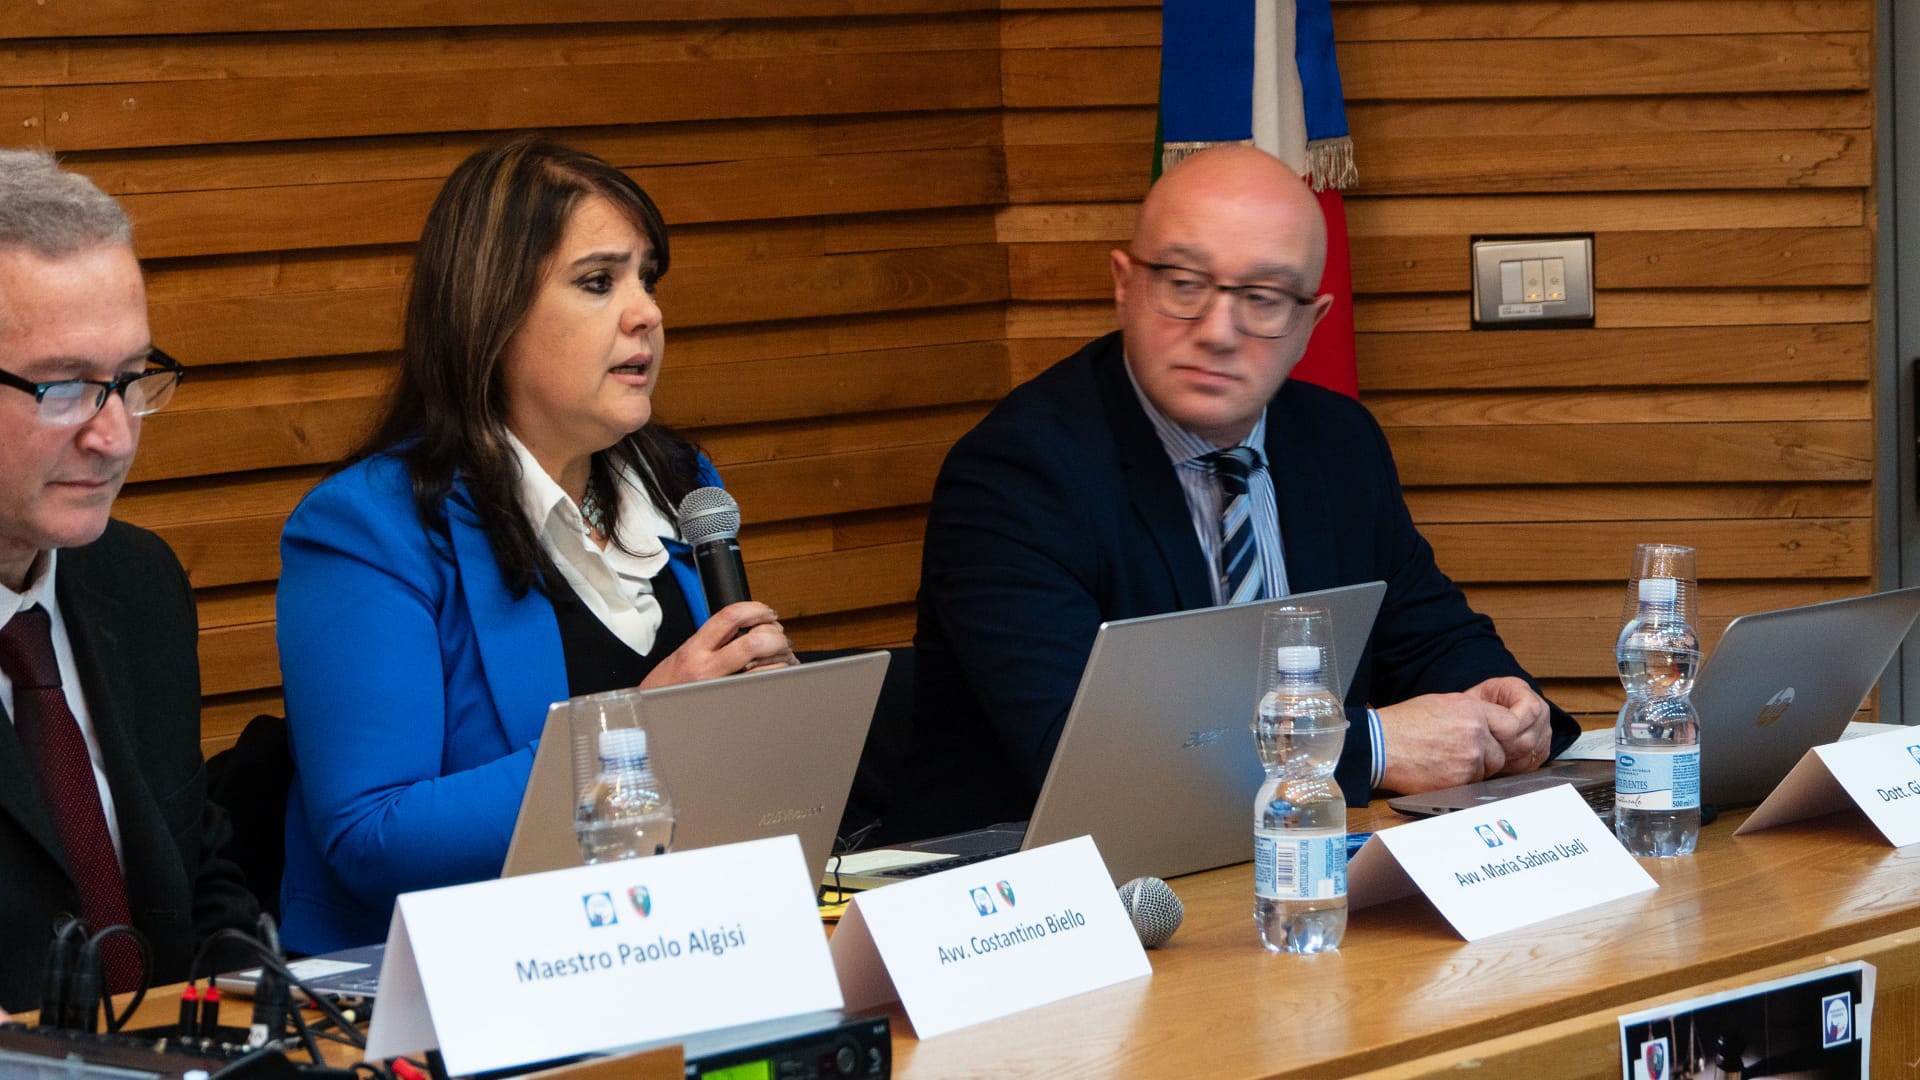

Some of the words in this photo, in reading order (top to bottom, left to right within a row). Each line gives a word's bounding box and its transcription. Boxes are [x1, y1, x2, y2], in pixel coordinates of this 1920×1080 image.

[1877, 786, 1912, 802] Dott.
[1454, 871, 1486, 887] Avv.
[1481, 858, 1520, 880] Maria
[1516, 850, 1559, 872] Sabina
[1554, 838, 1589, 859] Useli
[516, 951, 612, 983] Maestro
[617, 936, 681, 965] Paolo
[688, 923, 746, 956] Algisi
[938, 945, 971, 966] Avv.
[970, 923, 1046, 955] Costantino
[1044, 908, 1085, 934] Biello
